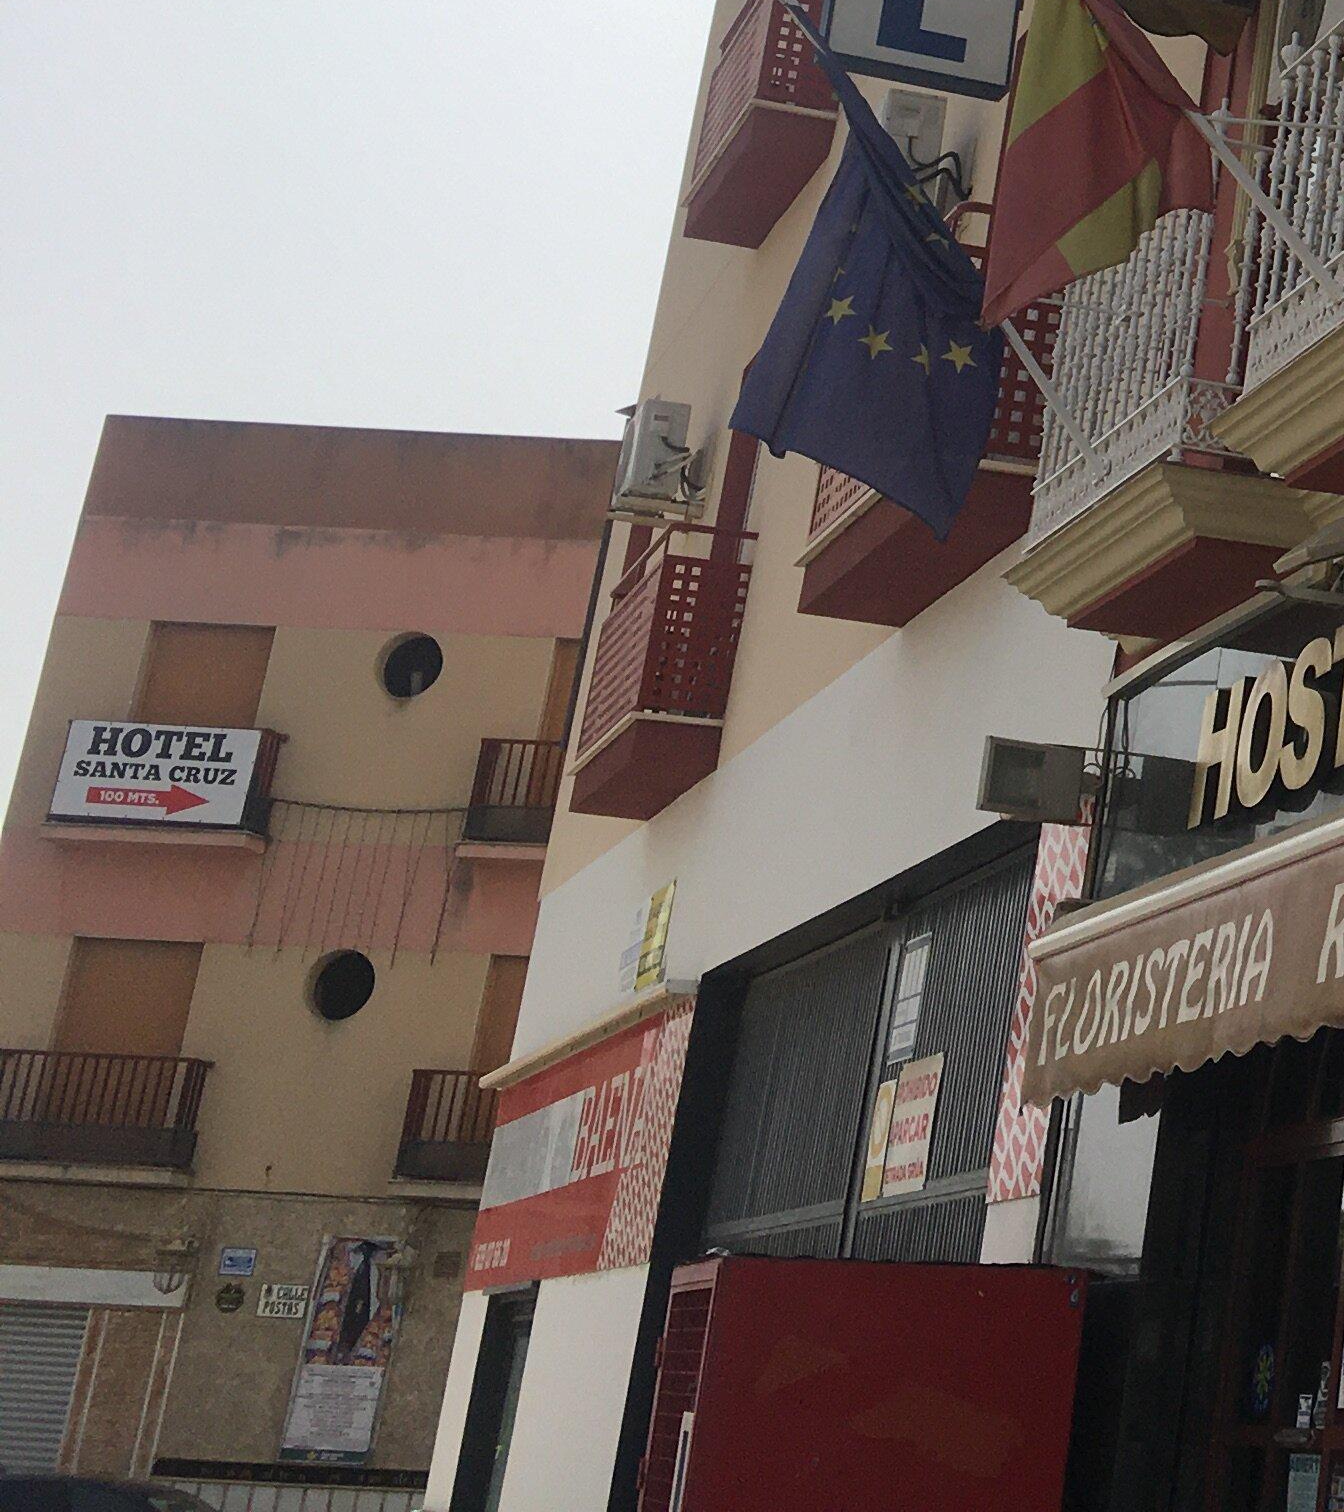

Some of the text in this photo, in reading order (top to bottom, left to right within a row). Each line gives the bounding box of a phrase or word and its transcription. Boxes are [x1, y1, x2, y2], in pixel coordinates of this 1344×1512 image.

[87, 726, 234, 763] HOTEL
[73, 759, 238, 785] SANTA CRUZ
[99, 789, 160, 804] 100 MTS.
[1037, 908, 1273, 1066] FLORISTERIA
